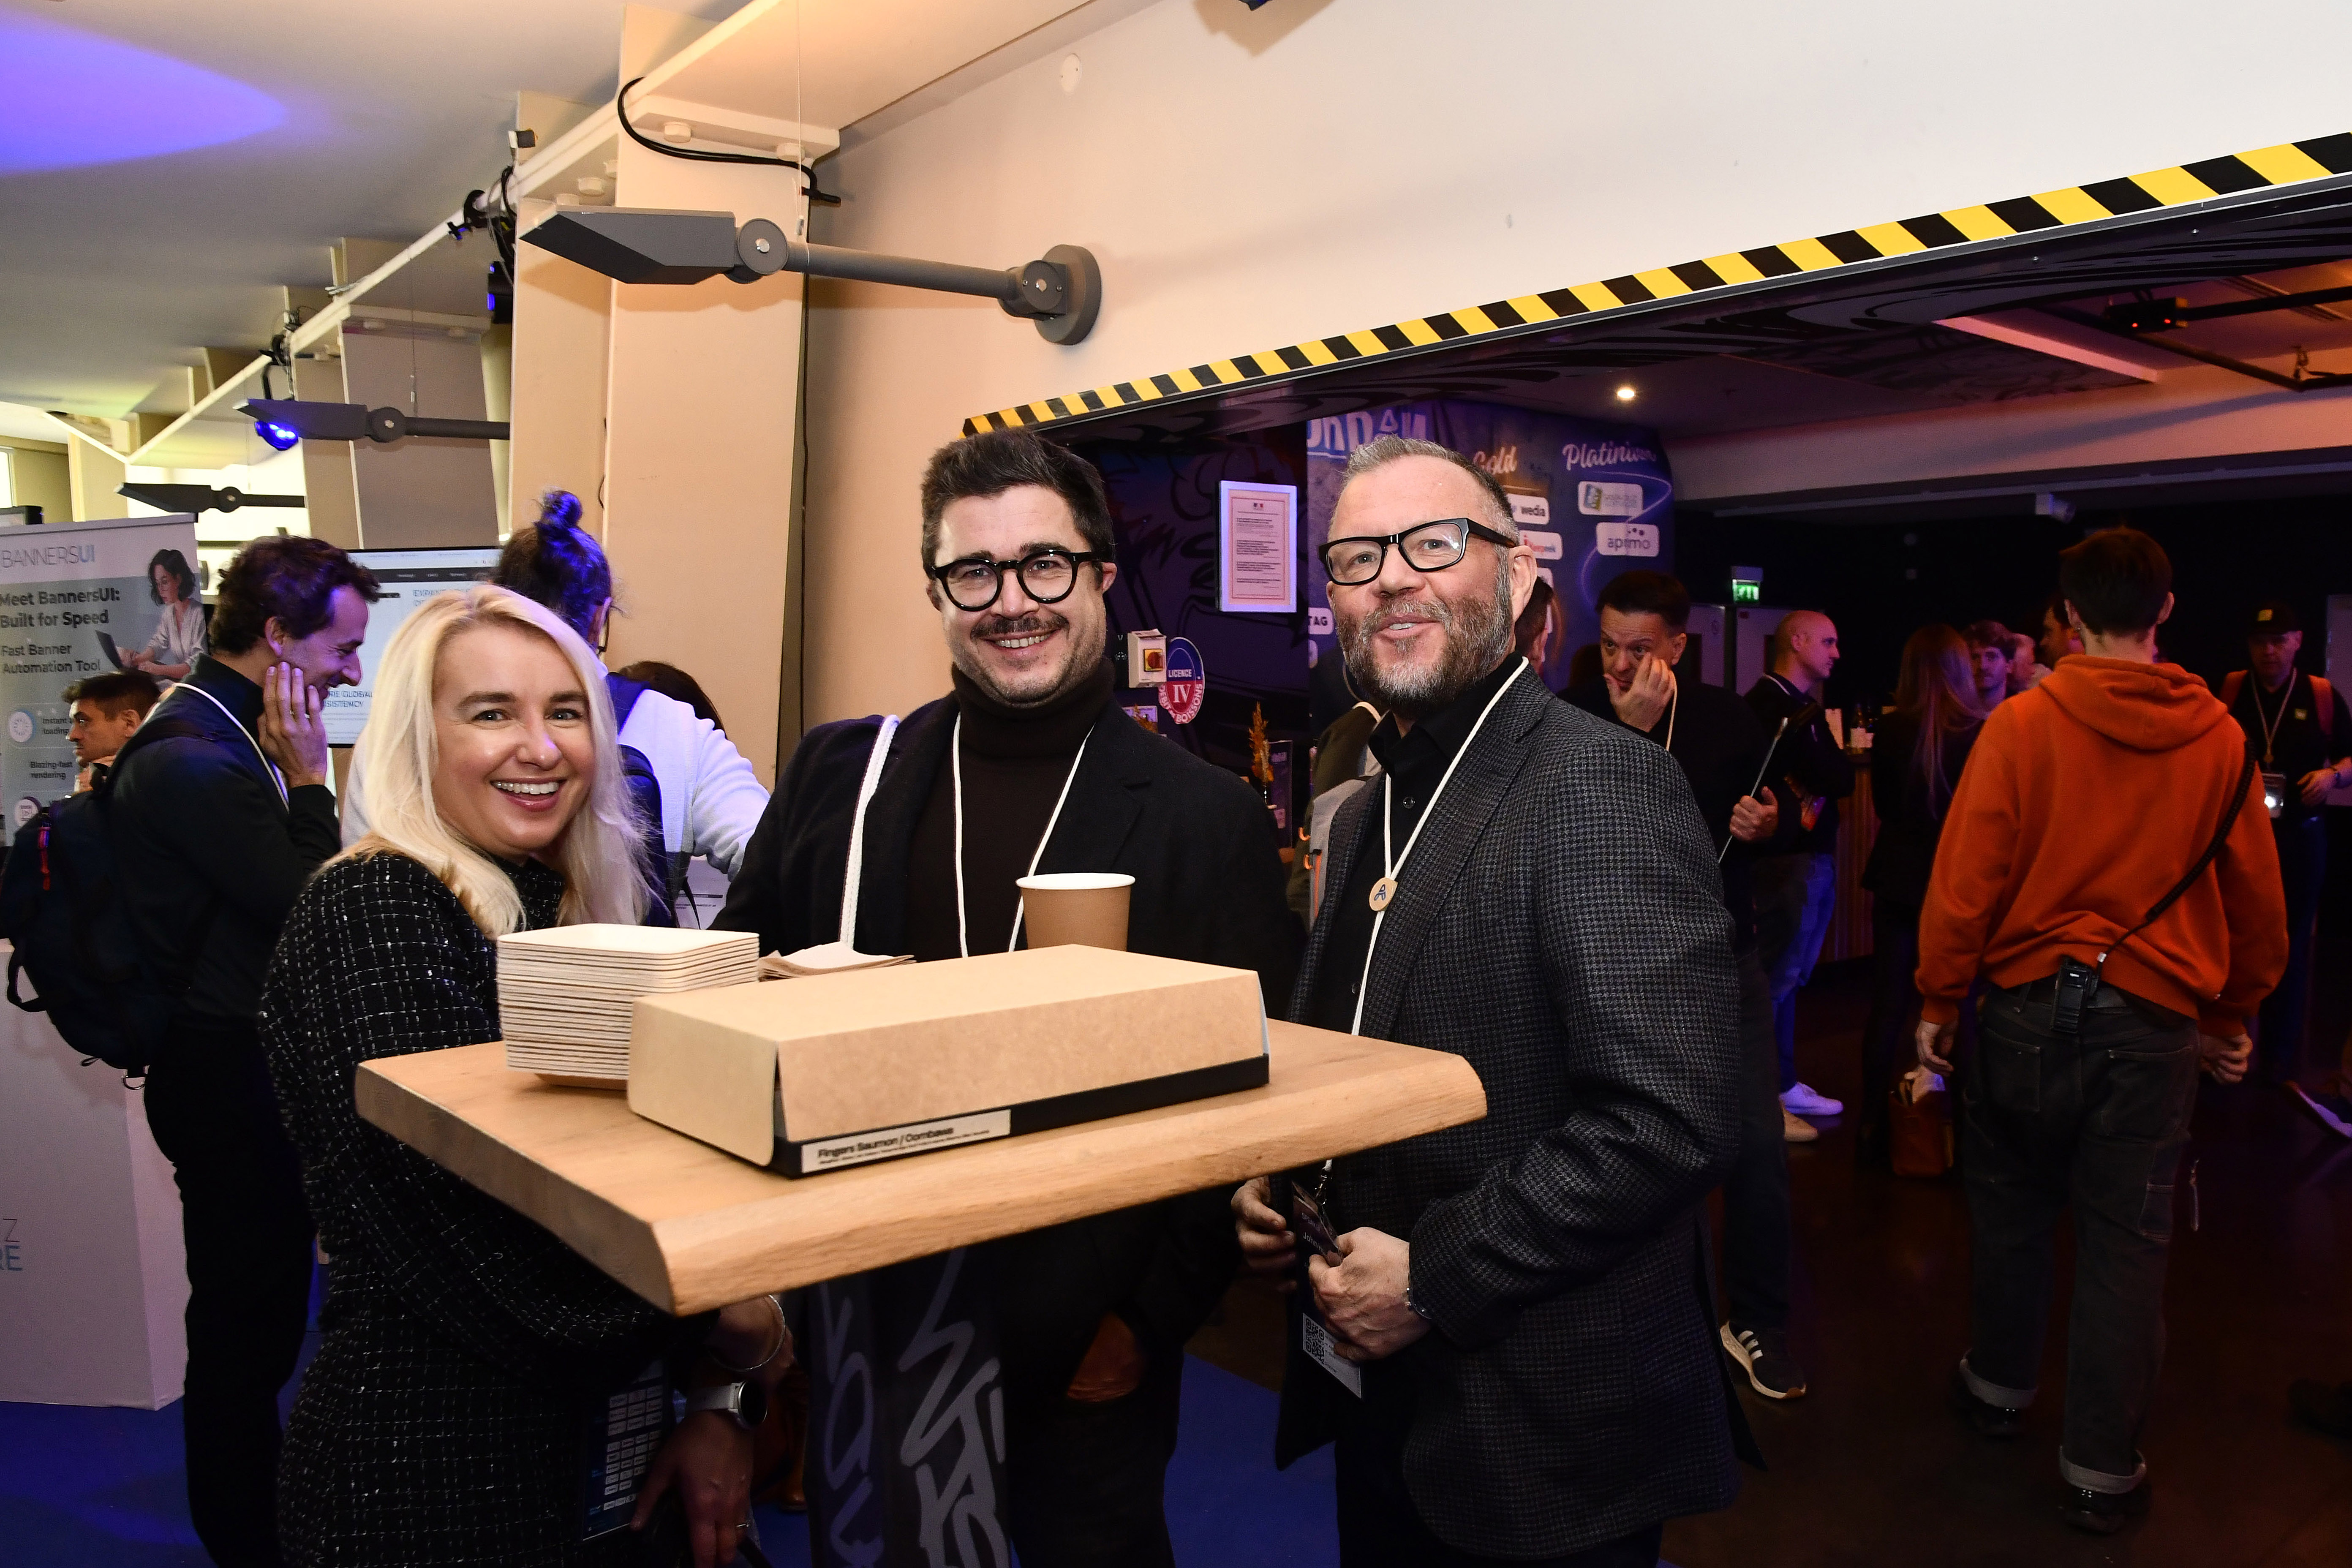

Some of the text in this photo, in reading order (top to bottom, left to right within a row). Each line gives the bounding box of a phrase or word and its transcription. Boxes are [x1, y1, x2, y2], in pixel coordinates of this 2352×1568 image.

[0, 587, 120, 606] Meet BannersUI:
[0, 610, 109, 629] Built for Speed
[2, 644, 72, 656] Fast Banner
[3, 659, 101, 674] Automation Tool
[1168, 669, 1192, 678] LICENCE
[1173, 684, 1192, 703] IV
[1176, 683, 1203, 723] BOISSONS
[30, 761, 73, 770] Blazing-fast
